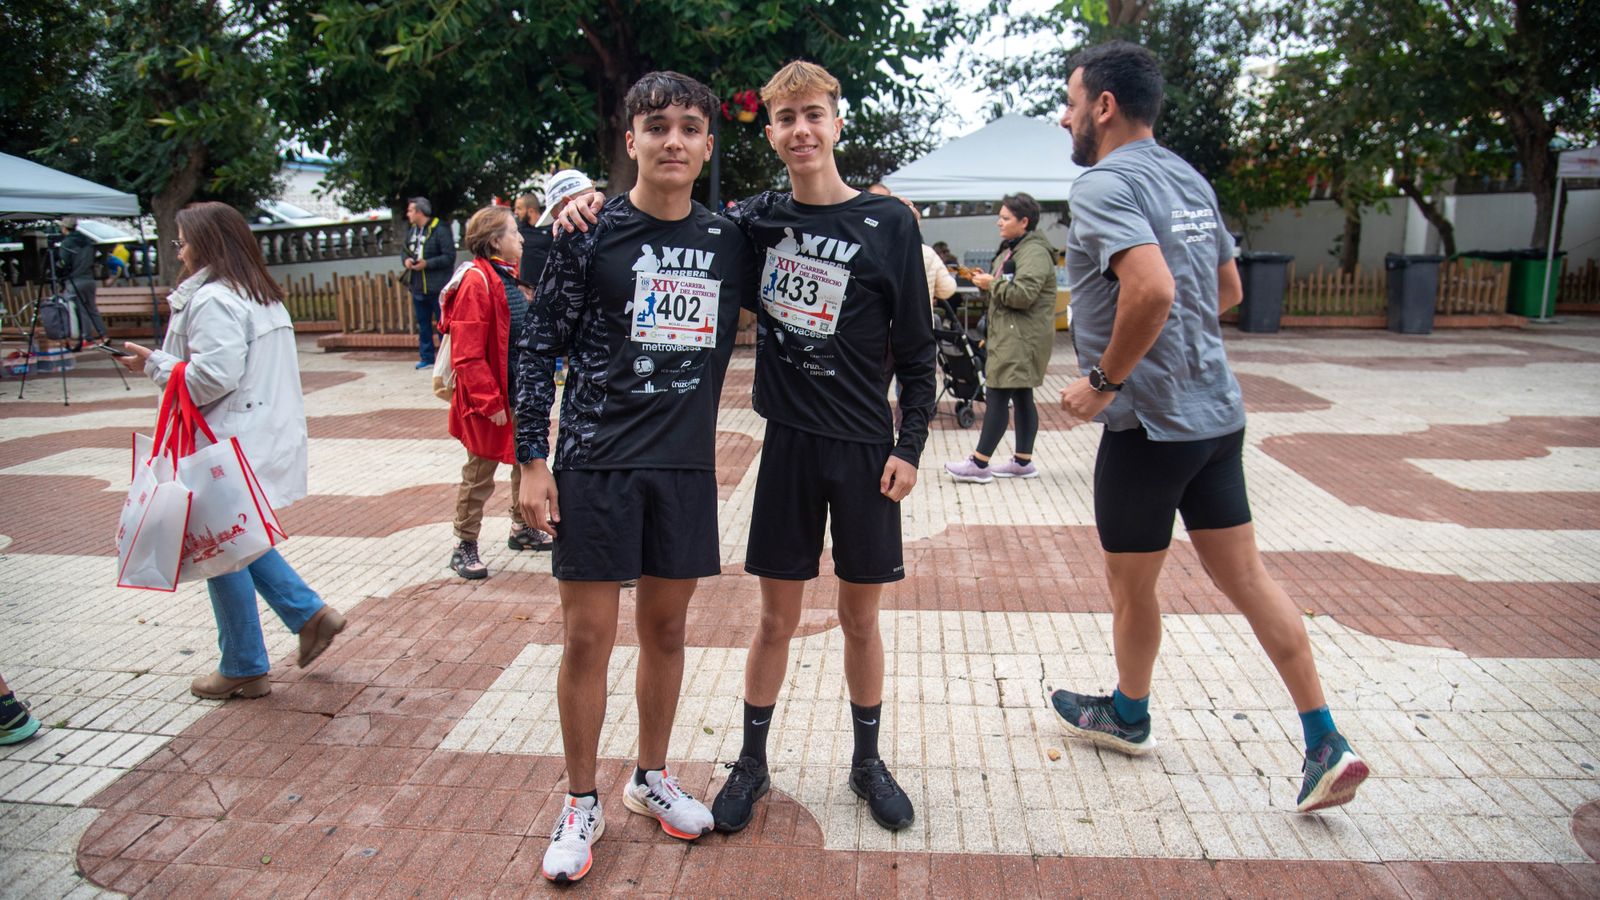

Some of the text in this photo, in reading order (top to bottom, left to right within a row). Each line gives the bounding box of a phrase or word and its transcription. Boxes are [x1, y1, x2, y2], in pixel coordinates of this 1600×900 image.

[800, 232, 862, 263] XIV
[661, 246, 715, 270] XIV
[775, 256, 801, 273] XIV
[799, 270, 842, 287] DEL ESTRECHO
[800, 264, 828, 276] CARRERA
[650, 278, 680, 293] XIV
[680, 281, 706, 290] CARRERA
[692, 289, 717, 298] ESTRECHO
[776, 272, 819, 306] 433
[656, 293, 701, 323] 402
